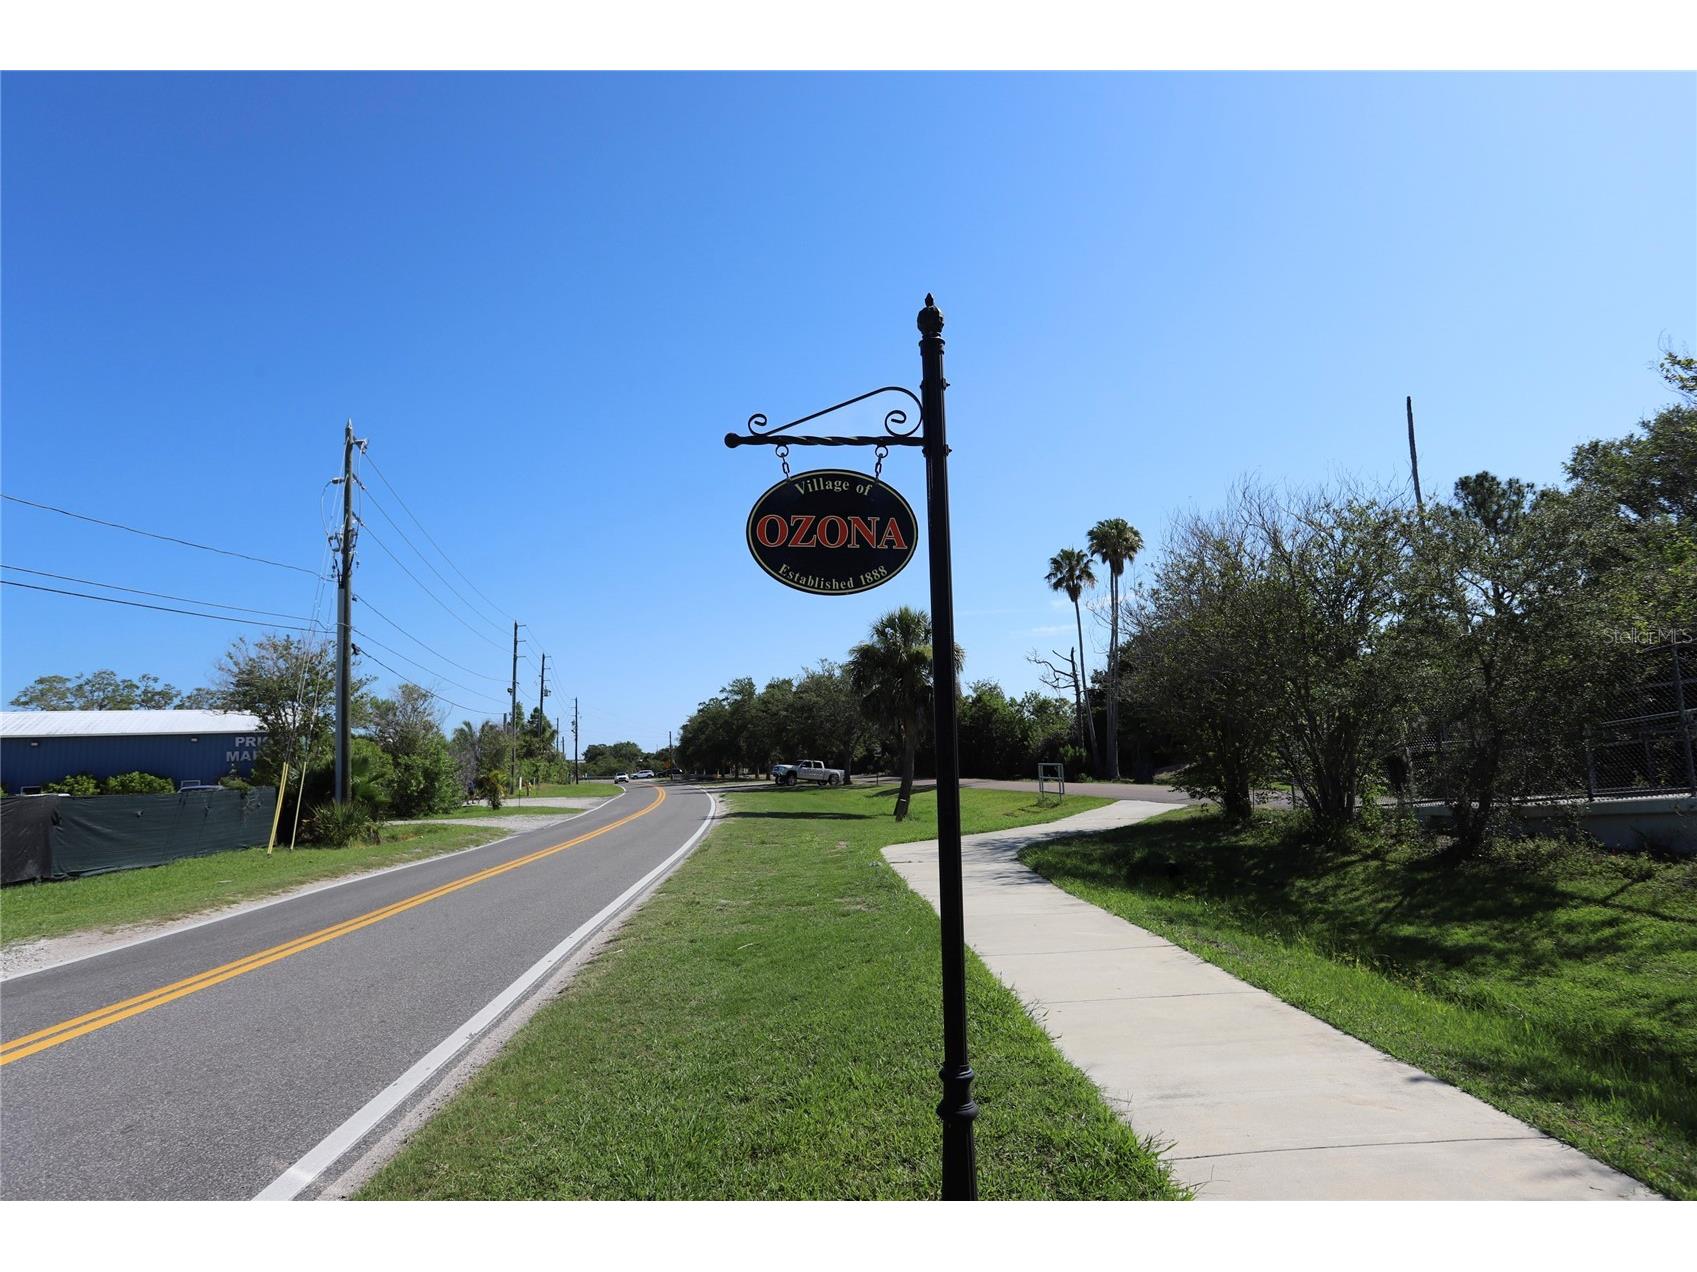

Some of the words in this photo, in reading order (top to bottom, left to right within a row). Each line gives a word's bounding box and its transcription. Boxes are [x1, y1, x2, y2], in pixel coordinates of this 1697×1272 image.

[795, 478, 850, 496] Village
[856, 484, 872, 496] of
[756, 514, 908, 549] OZONA
[778, 563, 854, 590] Established
[859, 565, 888, 585] 1888
